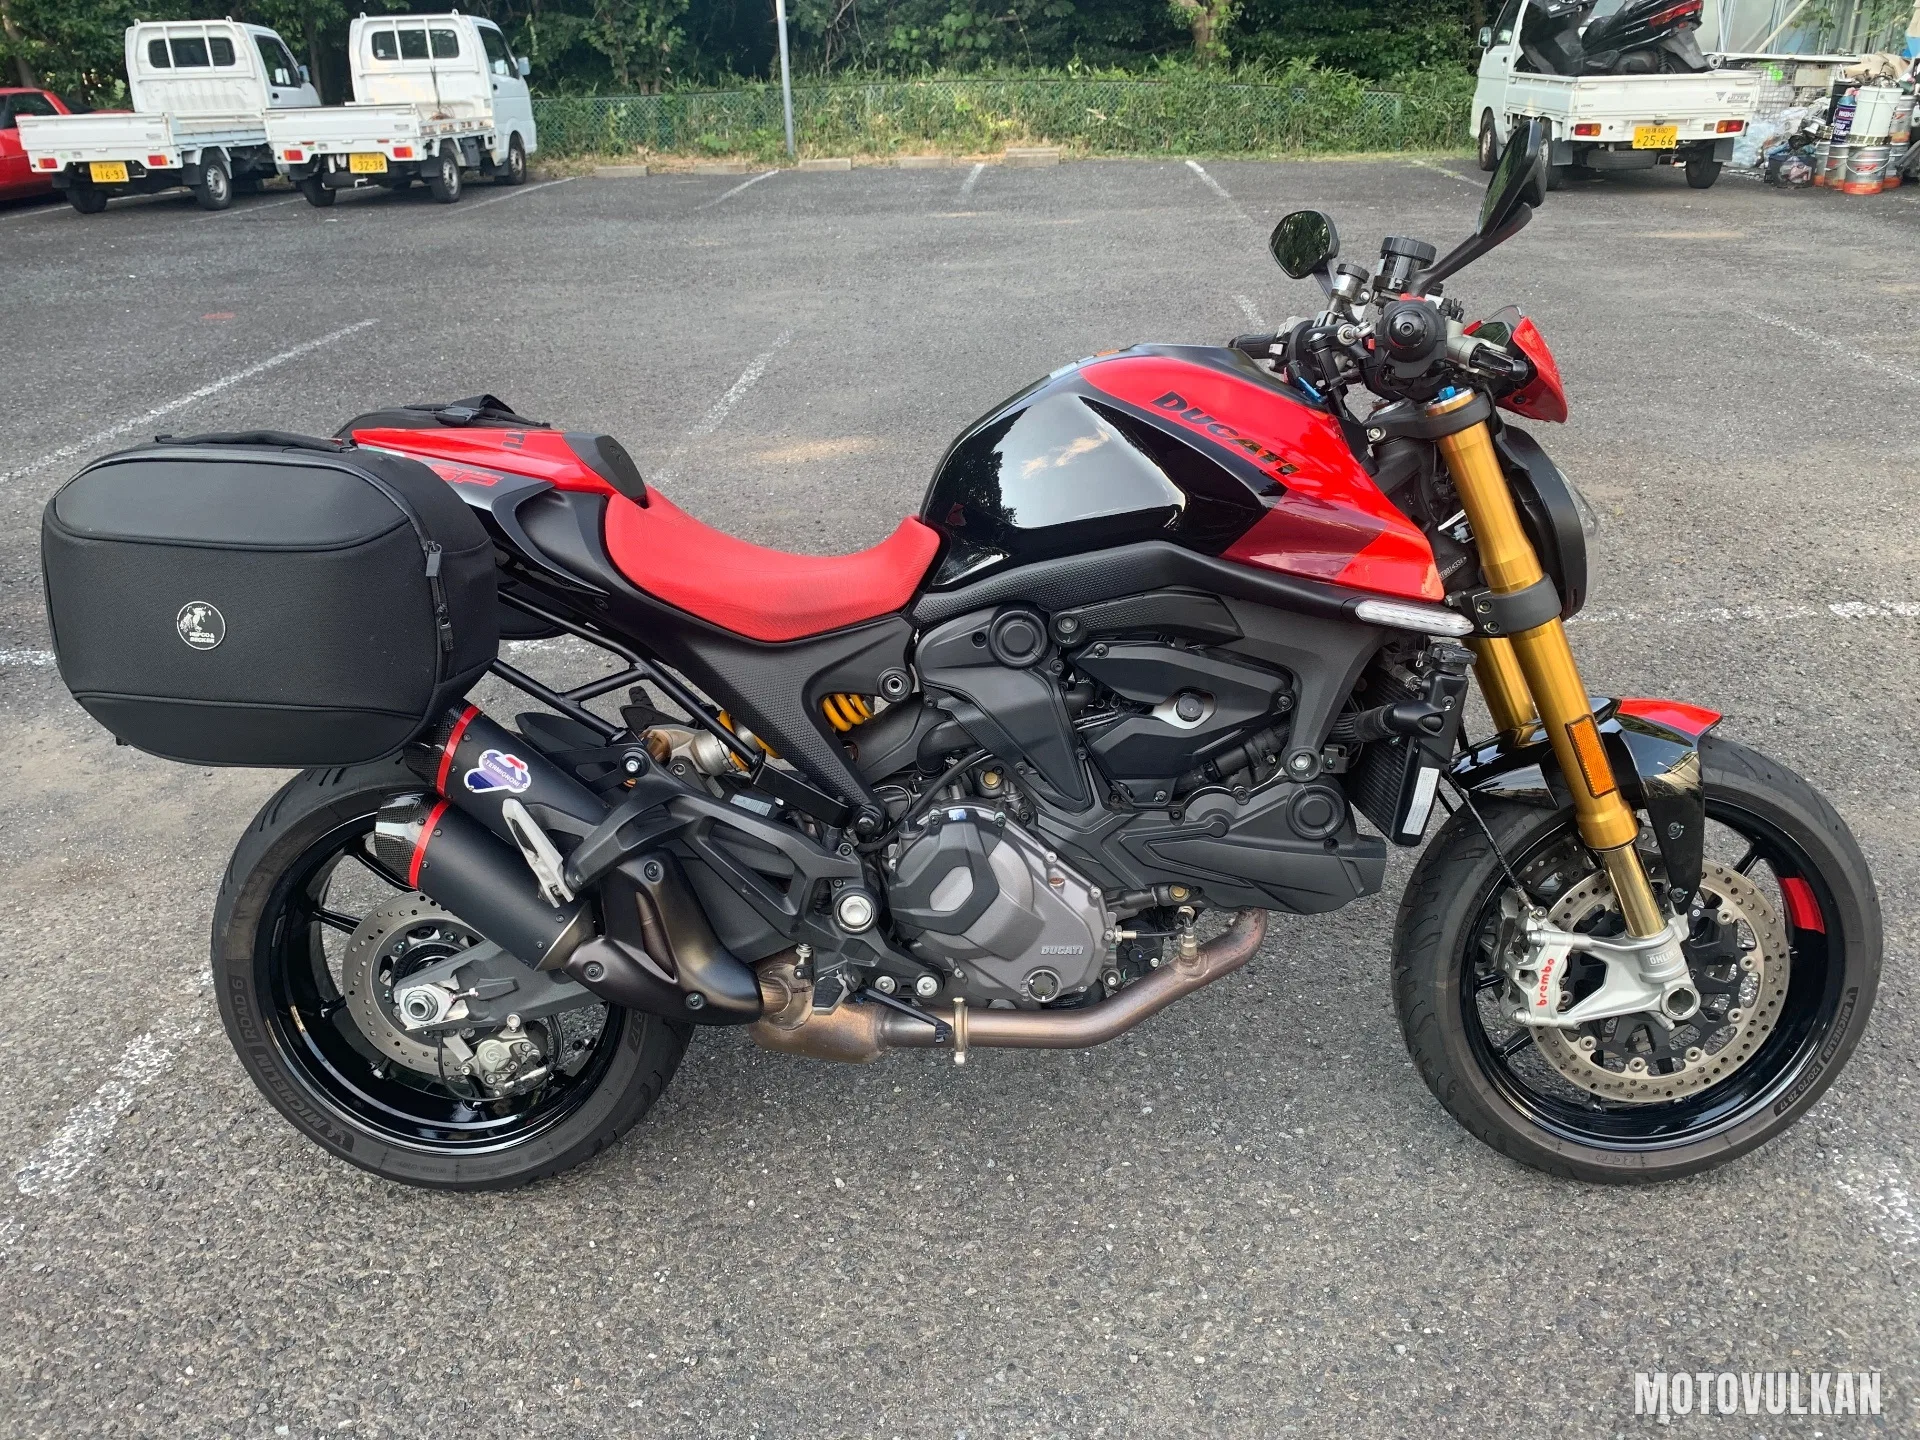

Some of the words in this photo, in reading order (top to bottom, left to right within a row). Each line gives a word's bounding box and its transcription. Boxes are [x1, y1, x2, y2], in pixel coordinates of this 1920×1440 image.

[1642, 135, 1675, 146] 25-66
[100, 169, 125, 180] 16-93
[358, 160, 385, 171] 32-38
[1150, 391, 1300, 475] DUCATI
[485, 759, 520, 788] TERMIGNONI
[1041, 945, 1084, 955] DUCATI
[231, 978, 244, 991] 6
[1536, 958, 1555, 1006] brembo
[234, 993, 257, 1039] ROAD
[1822, 1003, 1851, 1060] MICHELIN
[1798, 1066, 1821, 1092] 120/70
[255, 1053, 327, 1129] MICHELIN
[1787, 1092, 1799, 1102] ZR
[1780, 1101, 1789, 1111] 17
